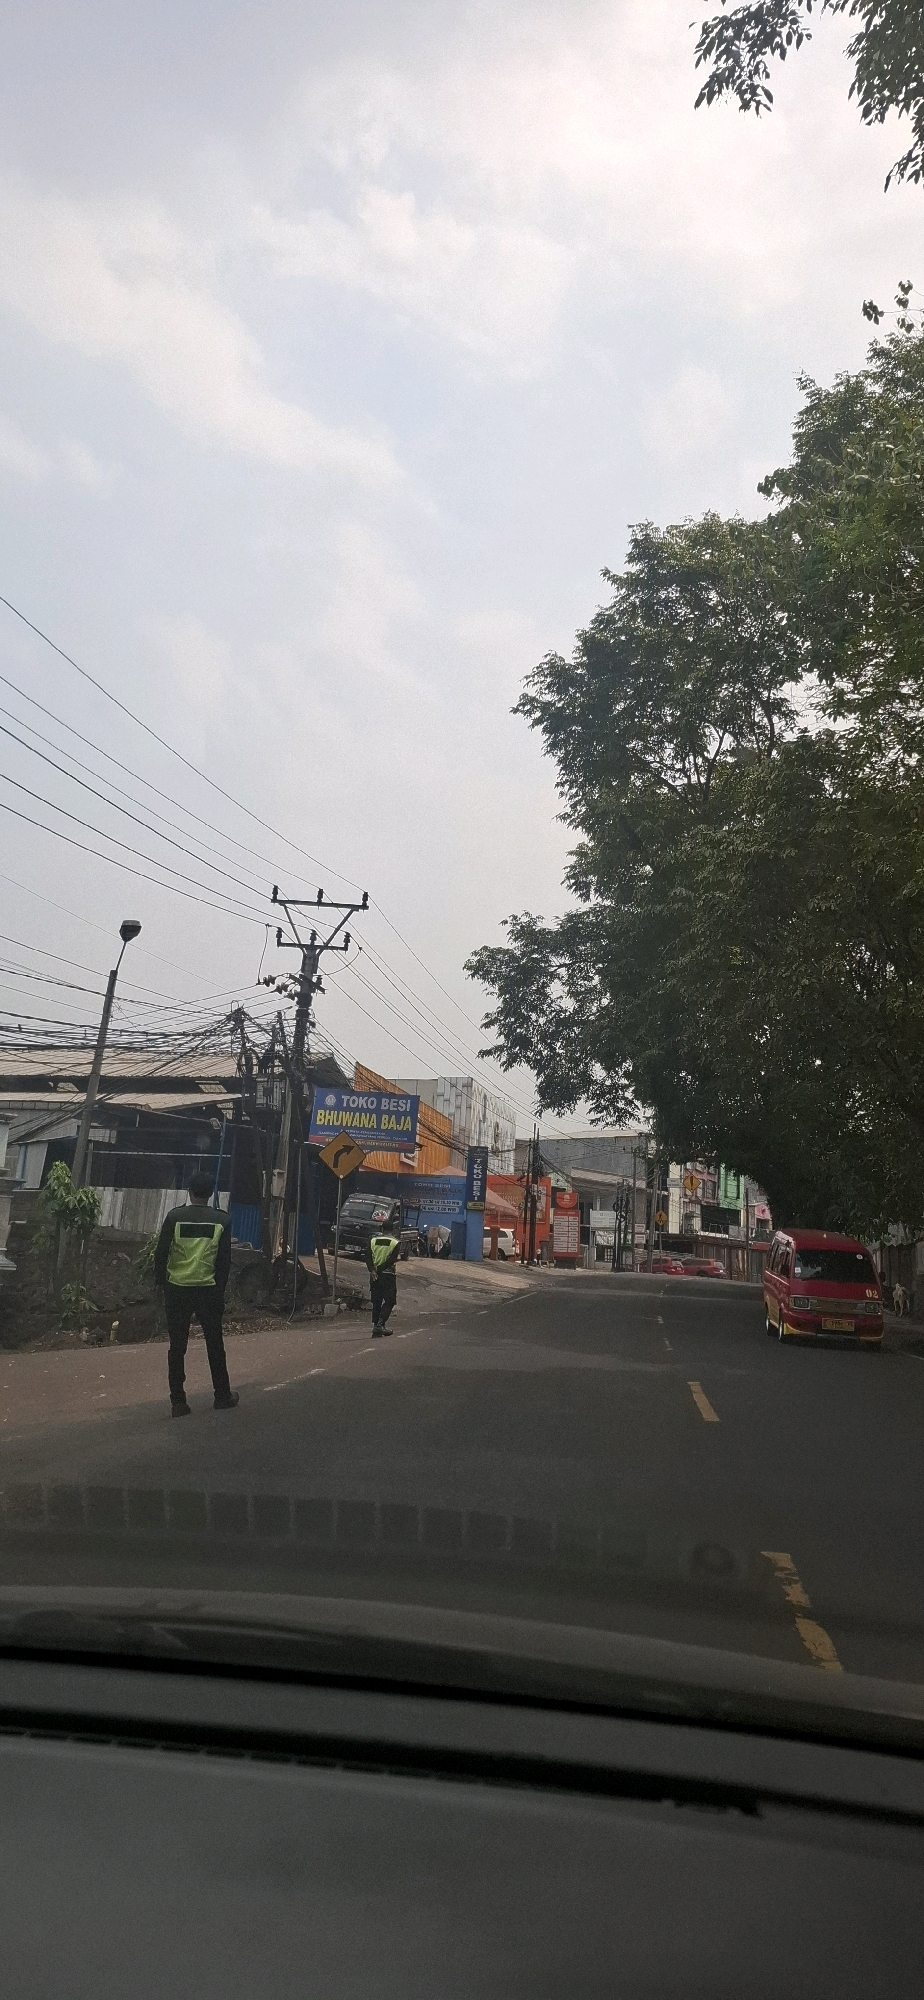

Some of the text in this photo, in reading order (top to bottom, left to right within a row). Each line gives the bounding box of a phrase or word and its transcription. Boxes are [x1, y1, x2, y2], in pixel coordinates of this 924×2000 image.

[341, 1094, 411, 1112] TOKO BESI
[316, 1109, 412, 1131] BHUWANA BAJA
[473, 1158, 482, 1179] TOKO
[472, 1180, 481, 1200] BESI
[865, 1289, 879, 1299] 02
